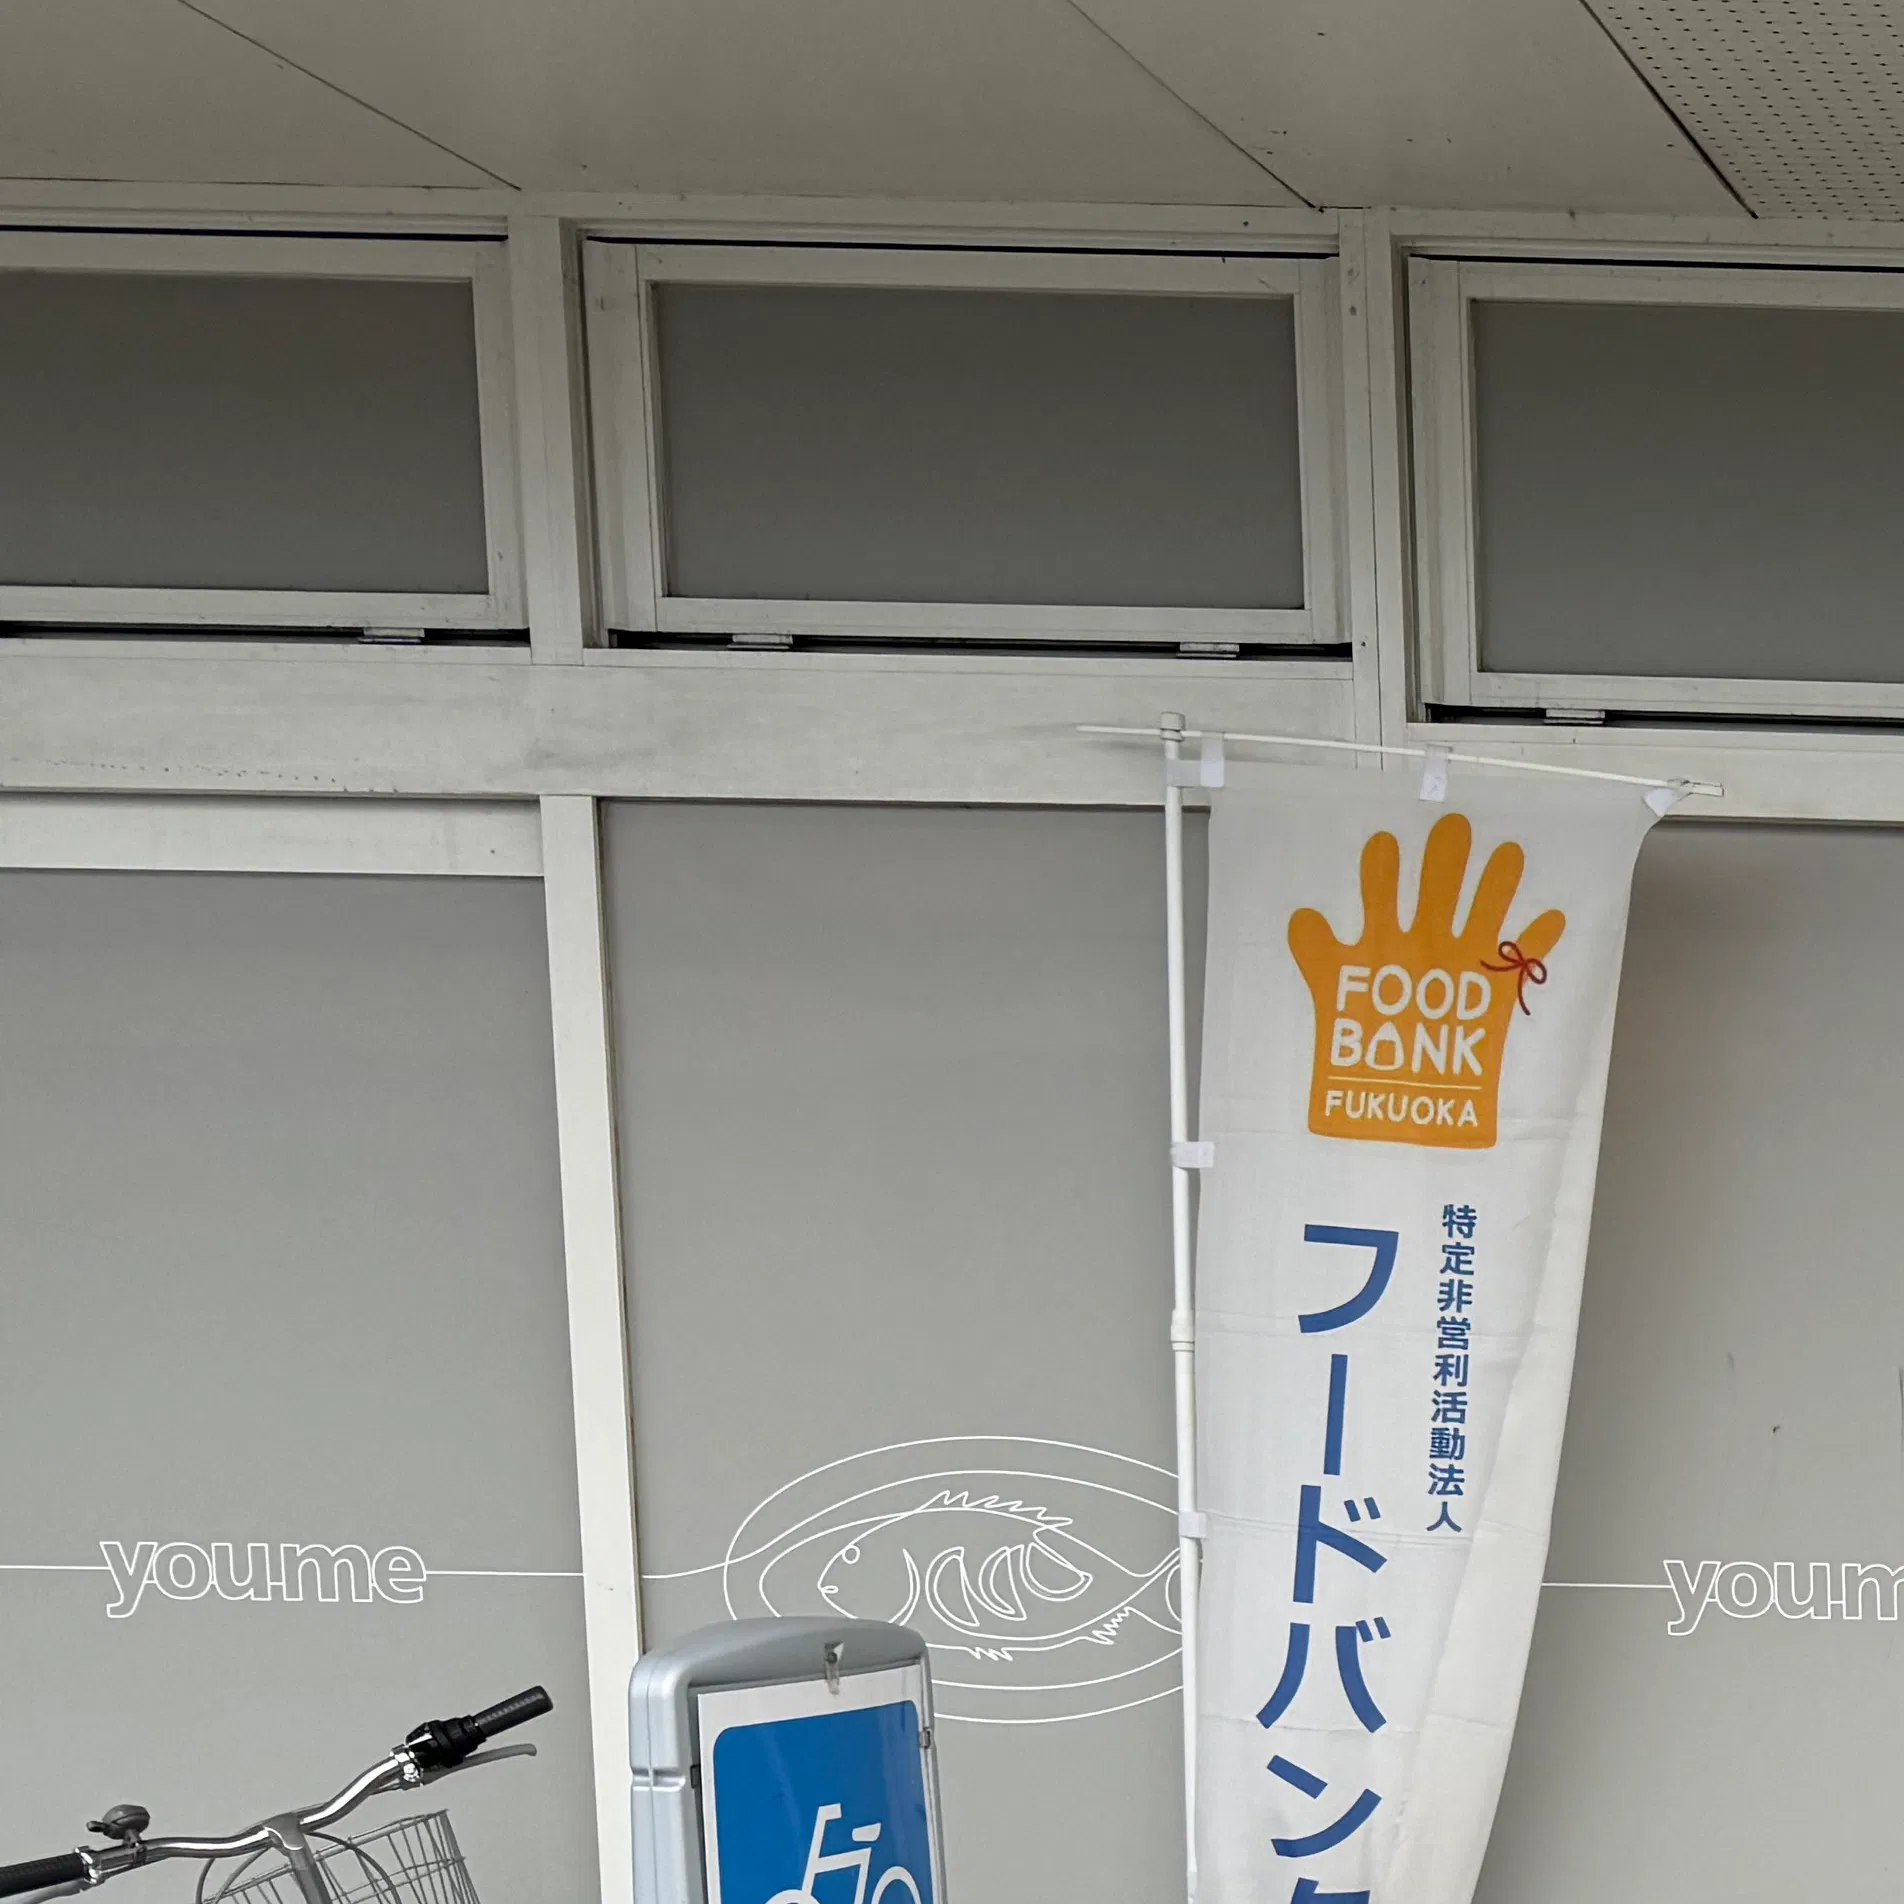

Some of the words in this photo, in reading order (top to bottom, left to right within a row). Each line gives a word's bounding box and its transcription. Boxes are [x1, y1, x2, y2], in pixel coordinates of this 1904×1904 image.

[1336, 964, 1492, 1020] FOOD
[1330, 1019, 1485, 1077] BANK
[1324, 1089, 1479, 1128] FUKUOKA
[1426, 1203, 1478, 1535] 特定非営利活動法人
[100, 1541, 427, 1618] youme
